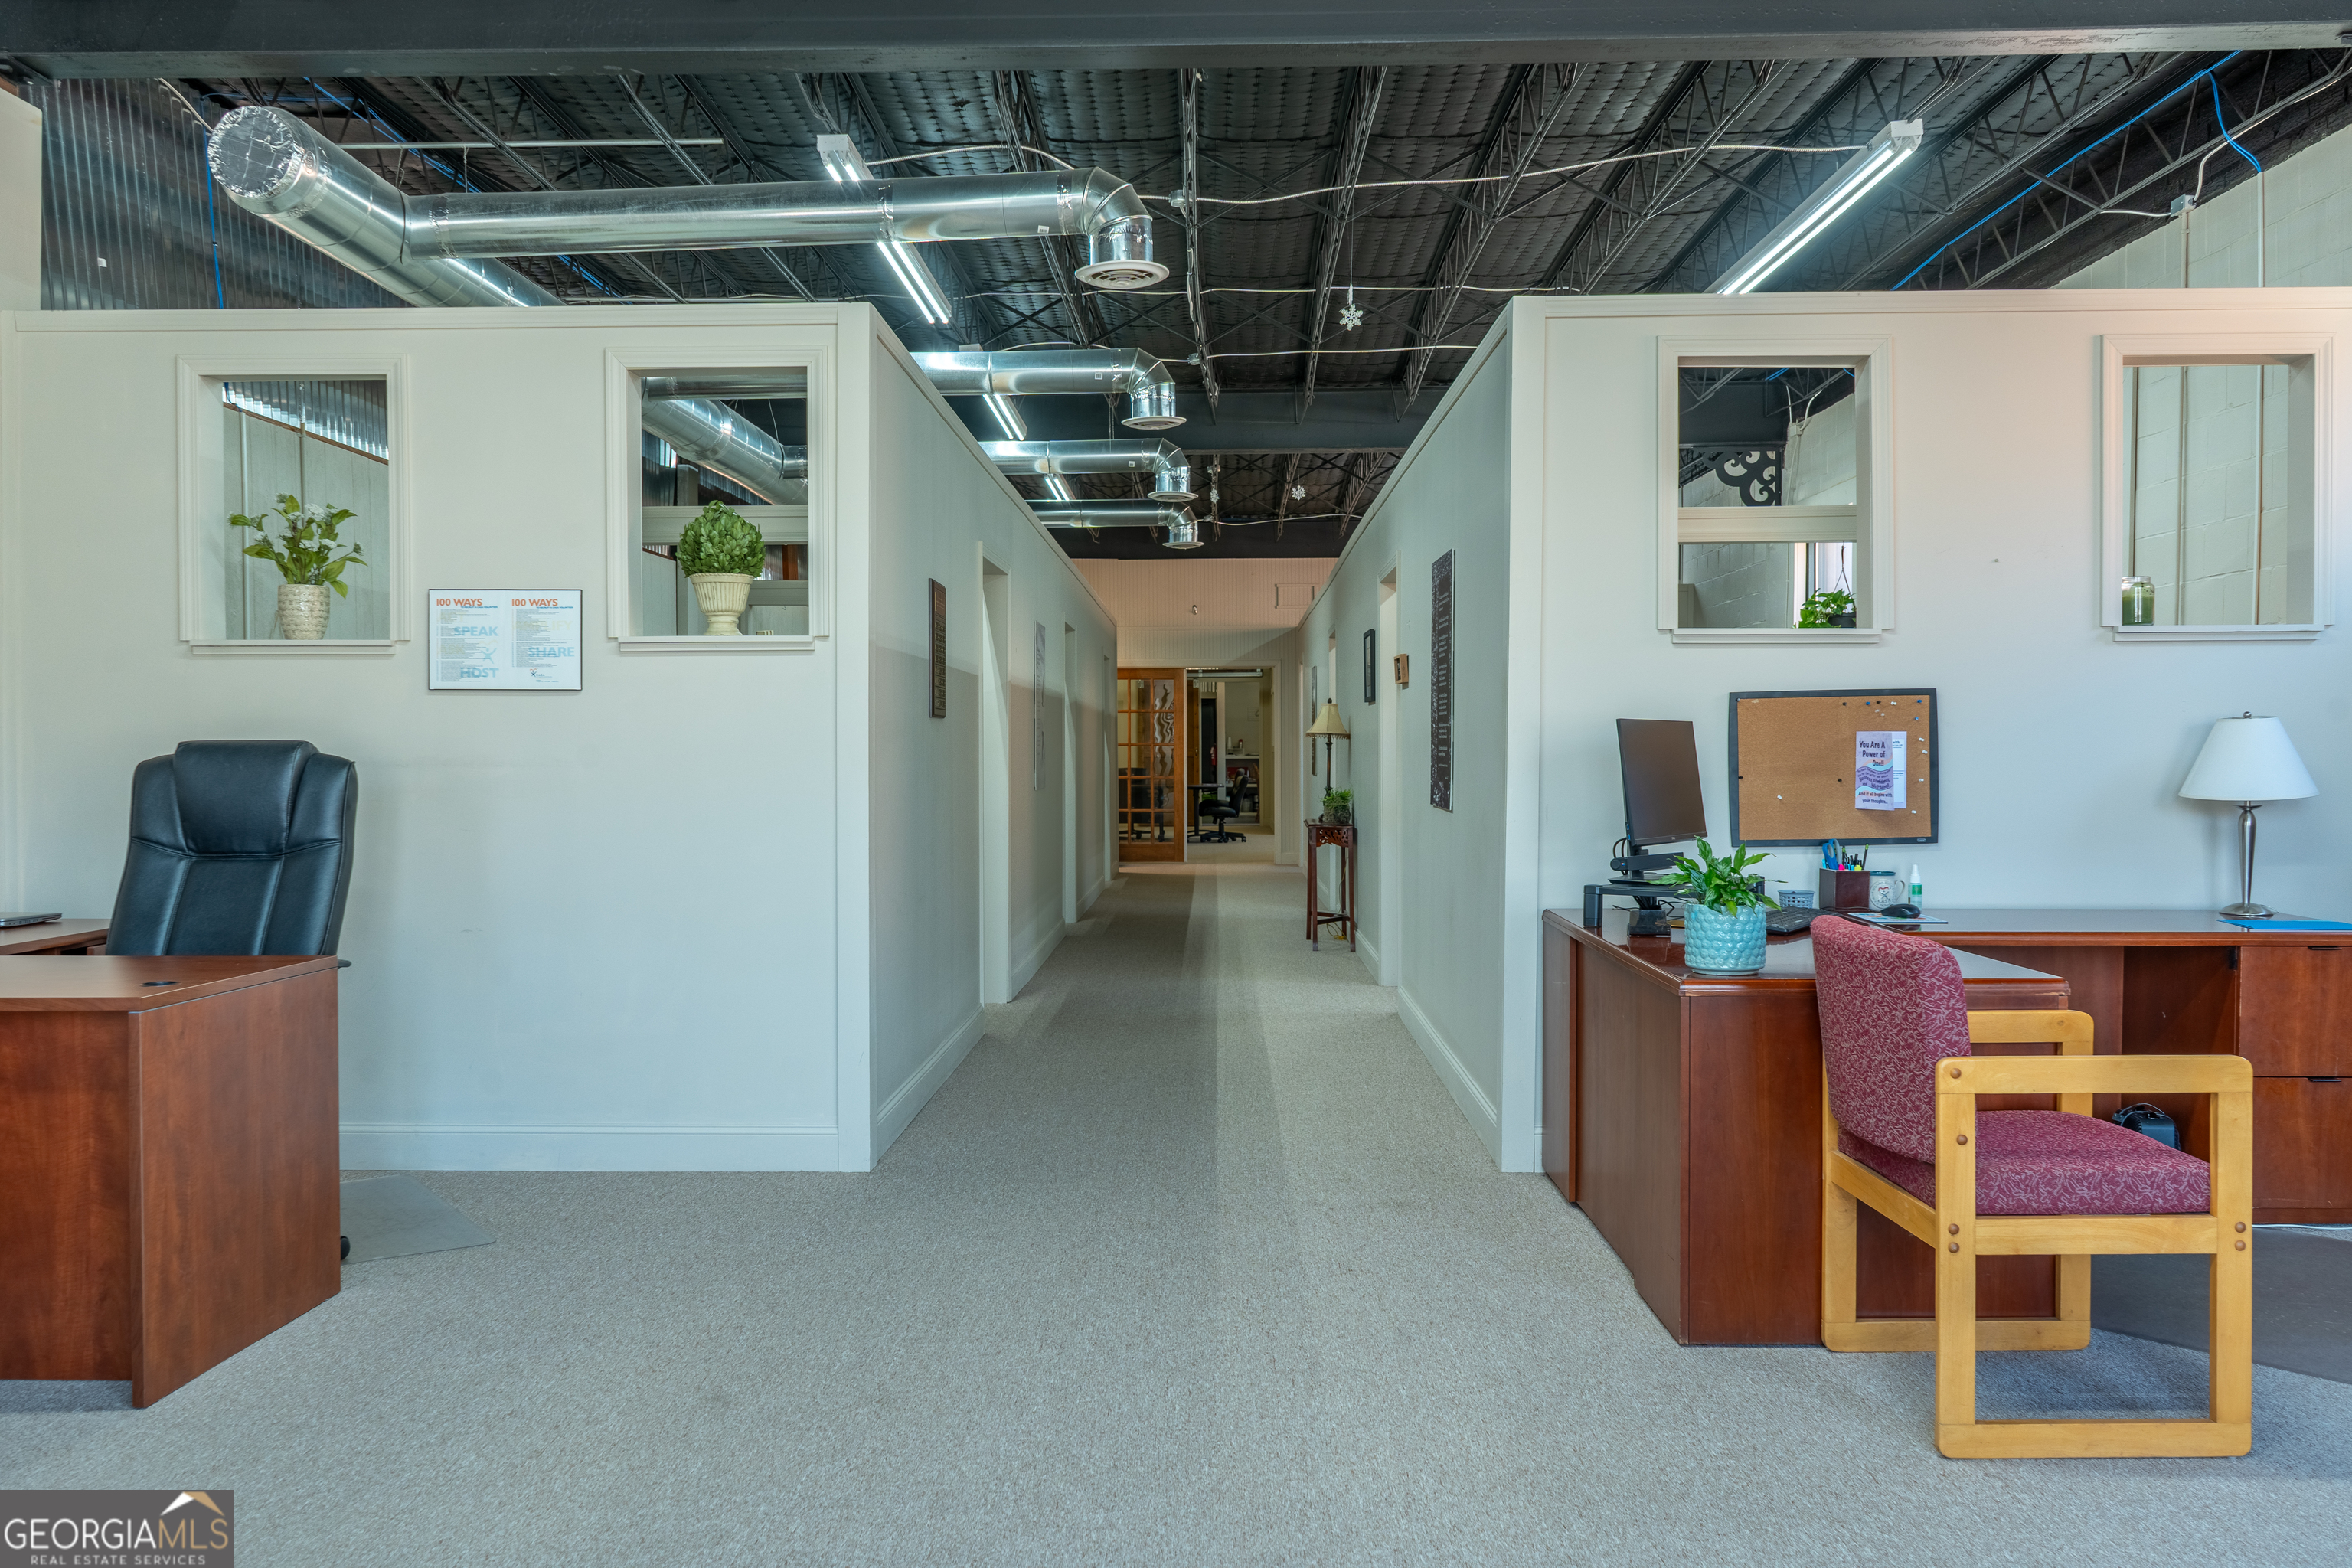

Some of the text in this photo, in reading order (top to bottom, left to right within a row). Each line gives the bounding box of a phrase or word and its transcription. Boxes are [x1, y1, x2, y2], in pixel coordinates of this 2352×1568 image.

[453, 626, 498, 636] SPEAK
[528, 646, 575, 657] SHARE
[460, 668, 499, 678] HOST
